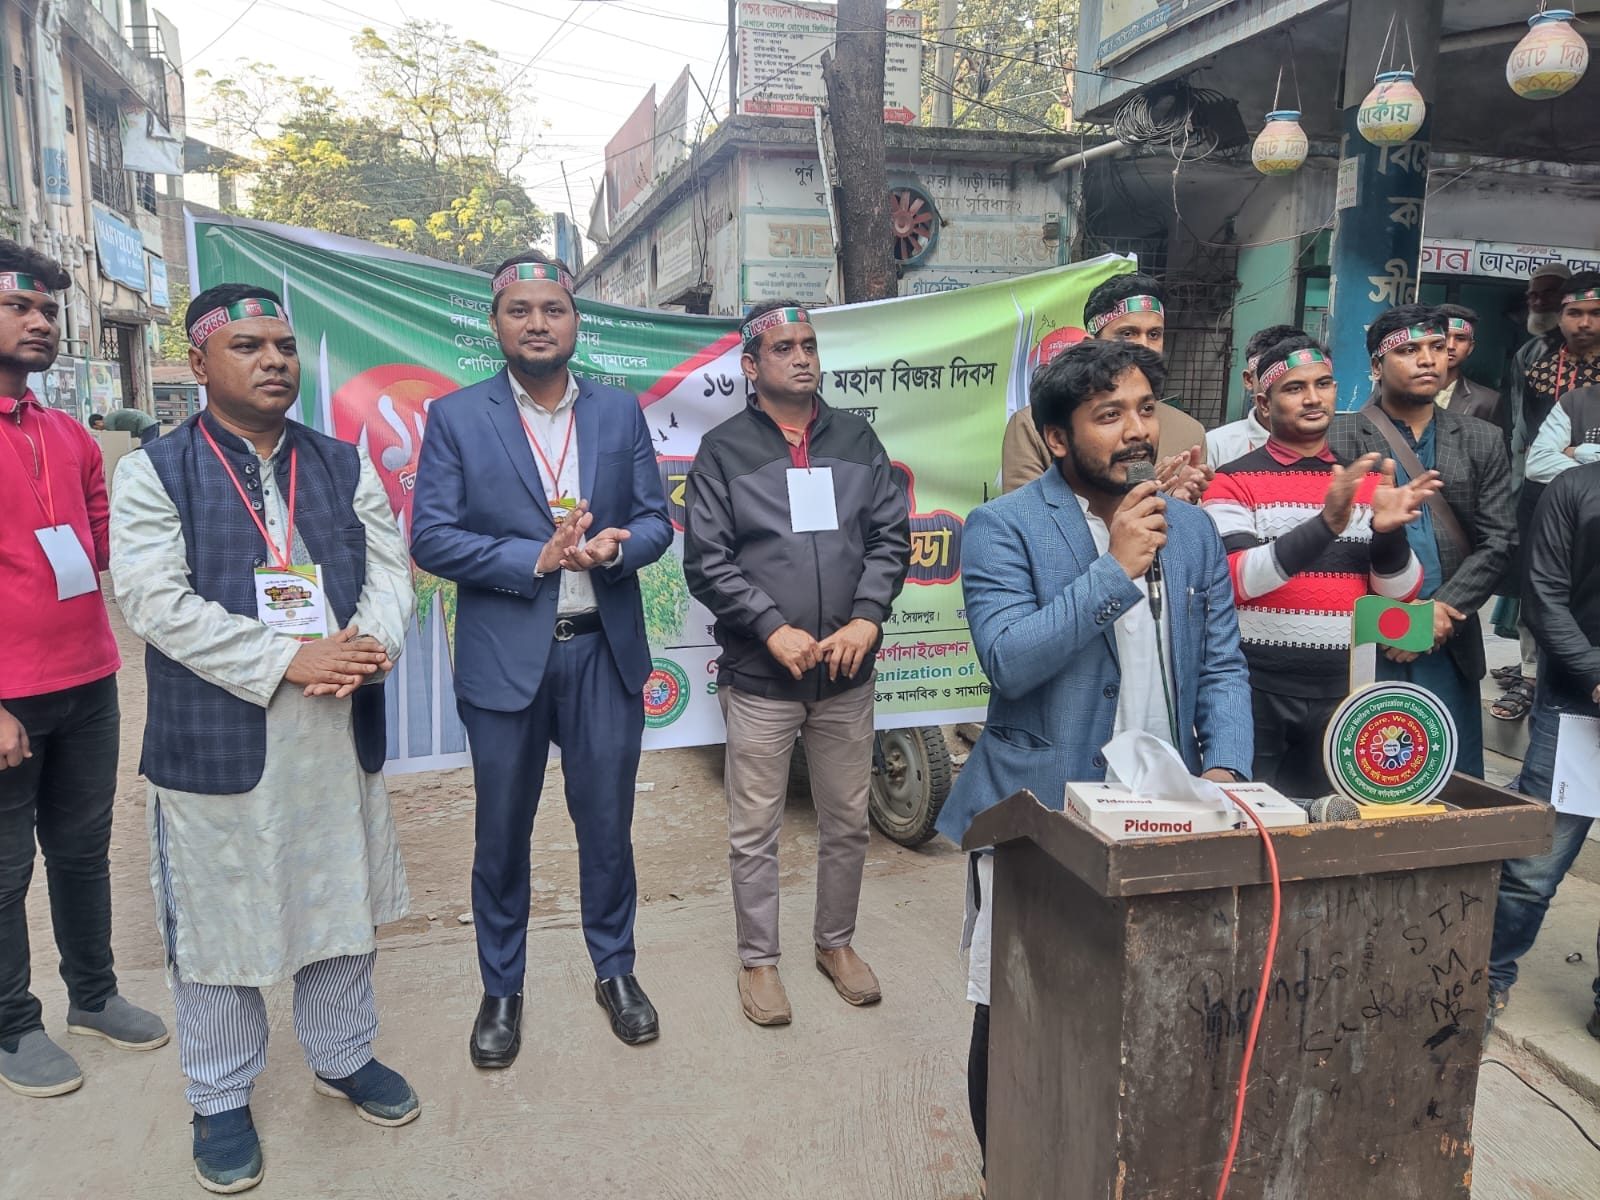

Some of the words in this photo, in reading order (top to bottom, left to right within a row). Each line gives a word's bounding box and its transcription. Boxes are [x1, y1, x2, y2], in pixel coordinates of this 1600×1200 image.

[588, 353, 649, 368] আমাদের
[702, 372, 736, 398] ১৬
[833, 365, 887, 398] মহান
[890, 358, 945, 394] বিজয়
[949, 356, 999, 389] দিবস
[876, 665, 952, 682] anization
[958, 662, 976, 677] of
[896, 686, 939, 702] মানবিক
[1360, 732, 1370, 745] We
[1392, 715, 1406, 724] We
[1407, 720, 1424, 743] Serve
[1125, 819, 1192, 833] Pidomod
